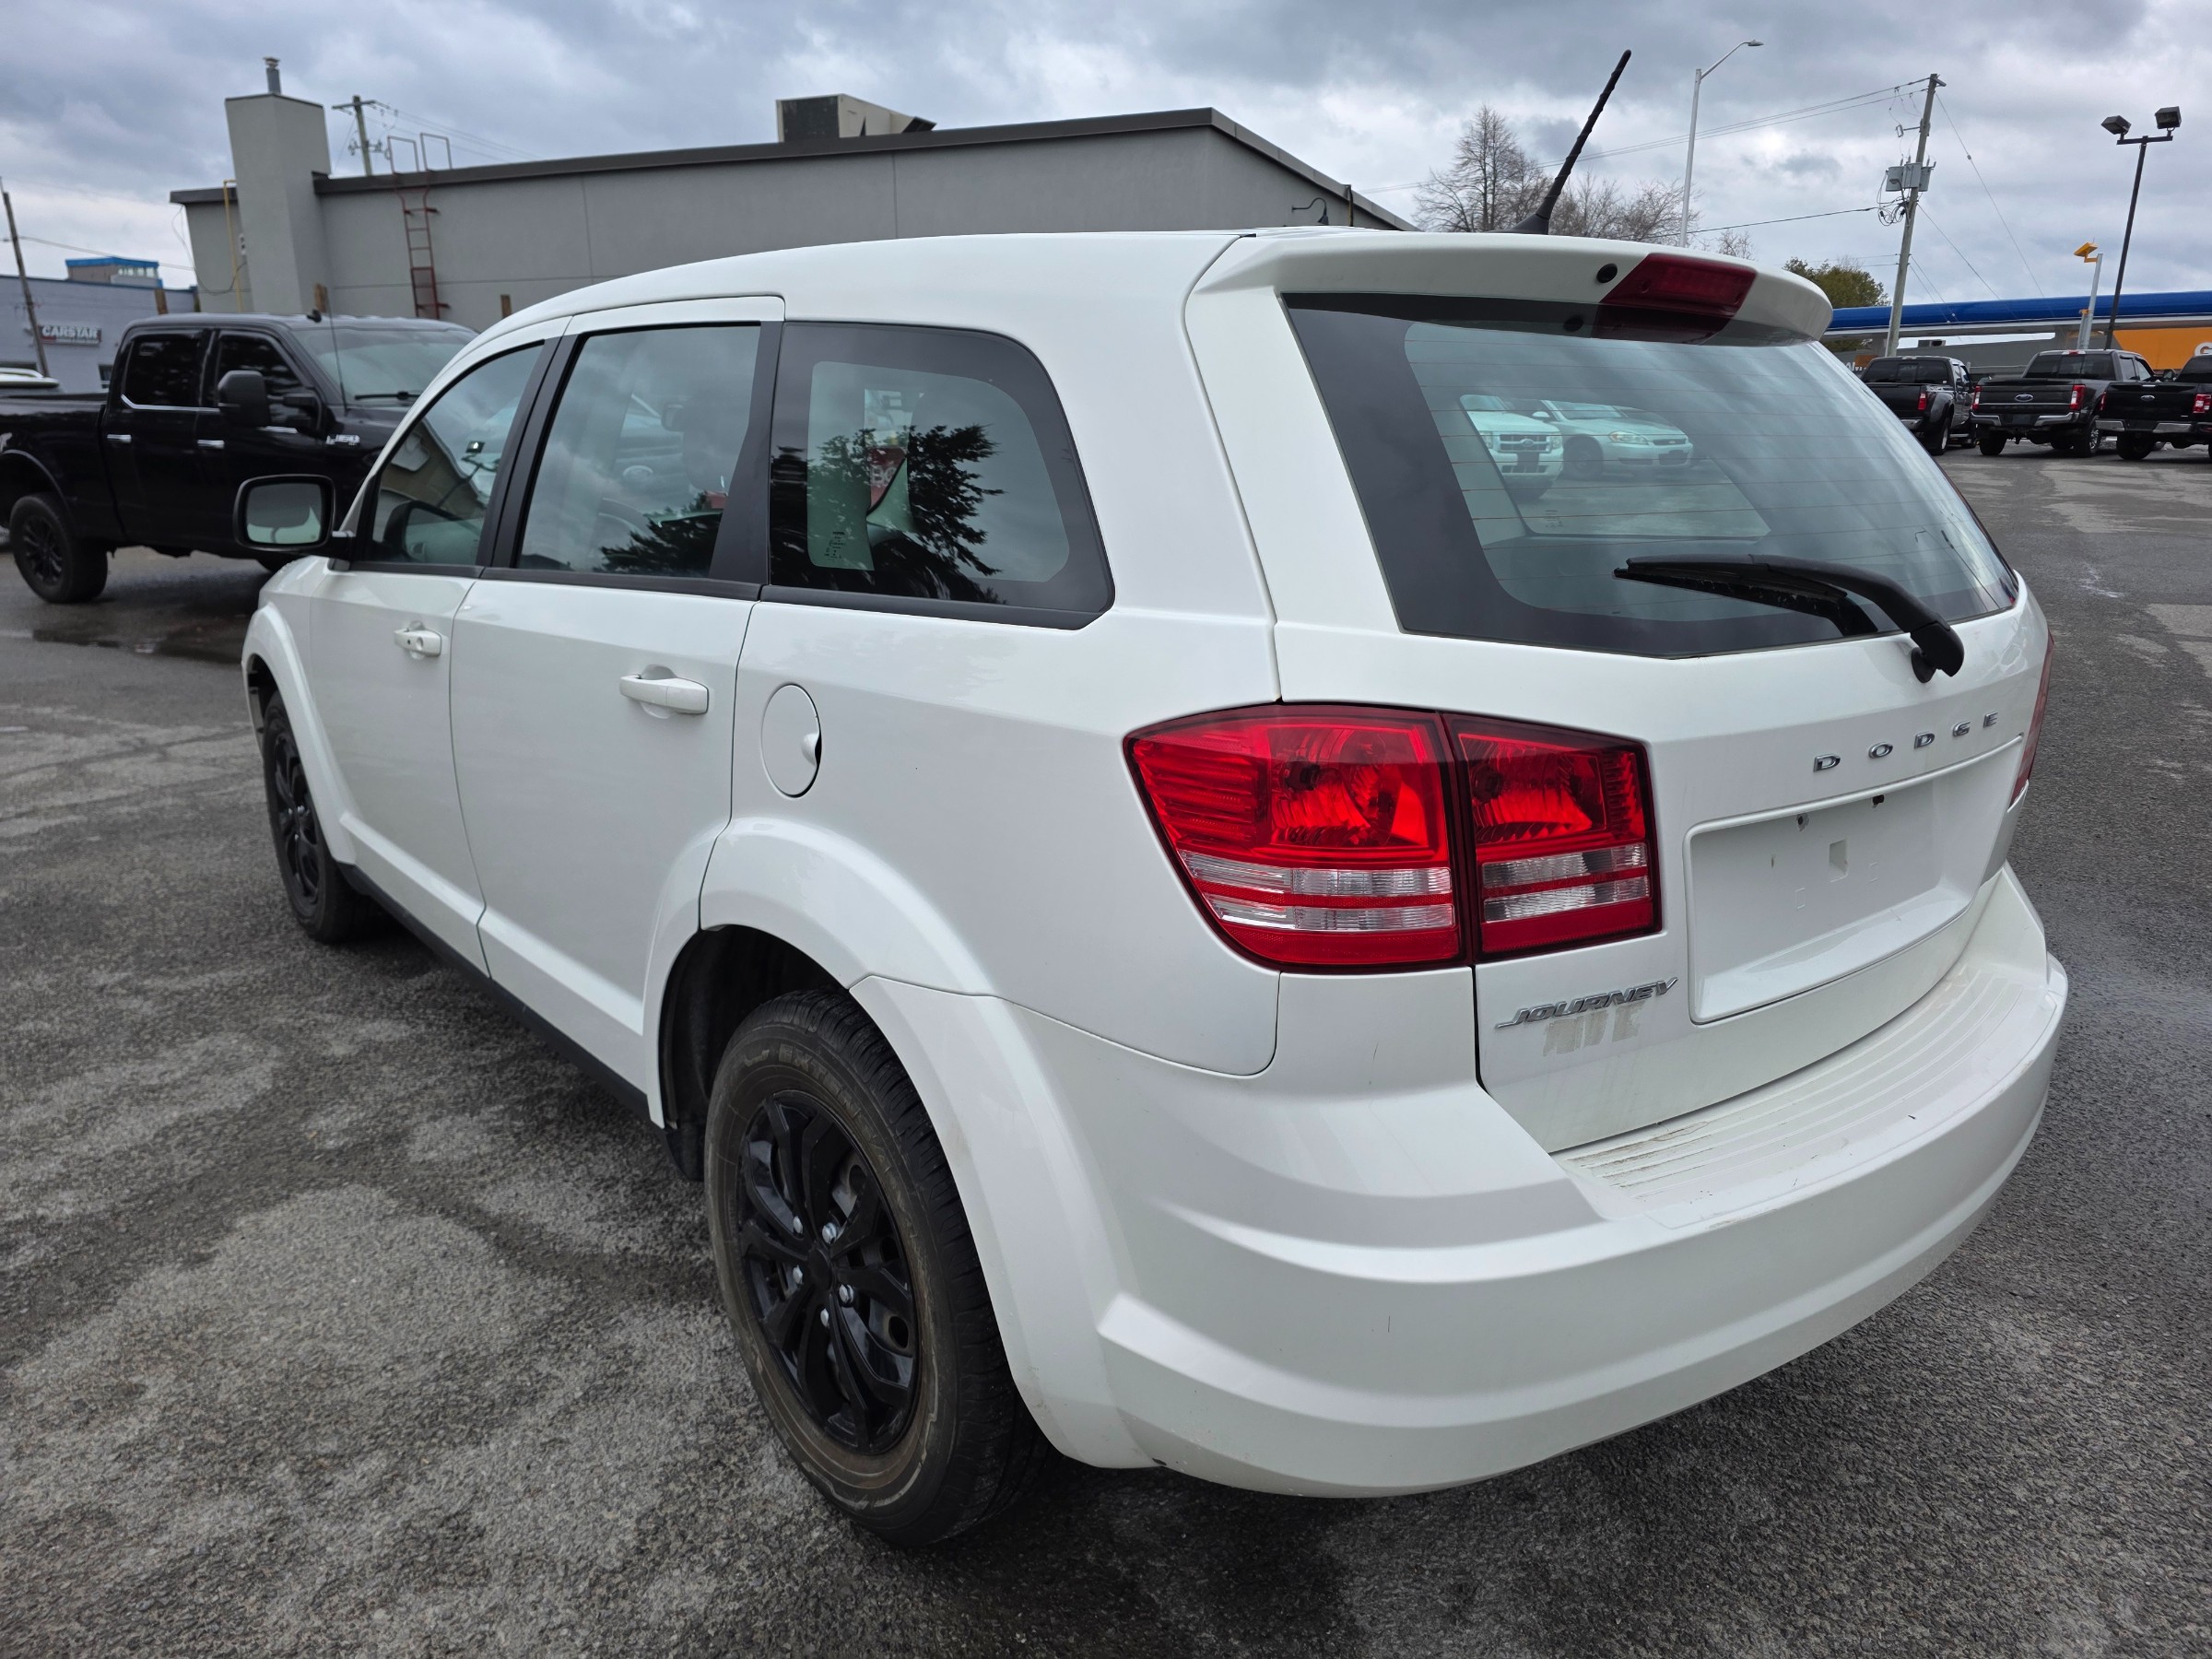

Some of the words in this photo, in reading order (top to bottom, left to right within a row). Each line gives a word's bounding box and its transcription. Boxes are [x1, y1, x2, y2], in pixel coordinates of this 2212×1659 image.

[41, 324, 99, 340] CARSTAR
[1813, 712, 1998, 772] DODGE
[1495, 977, 1678, 1029] JOURNEY
